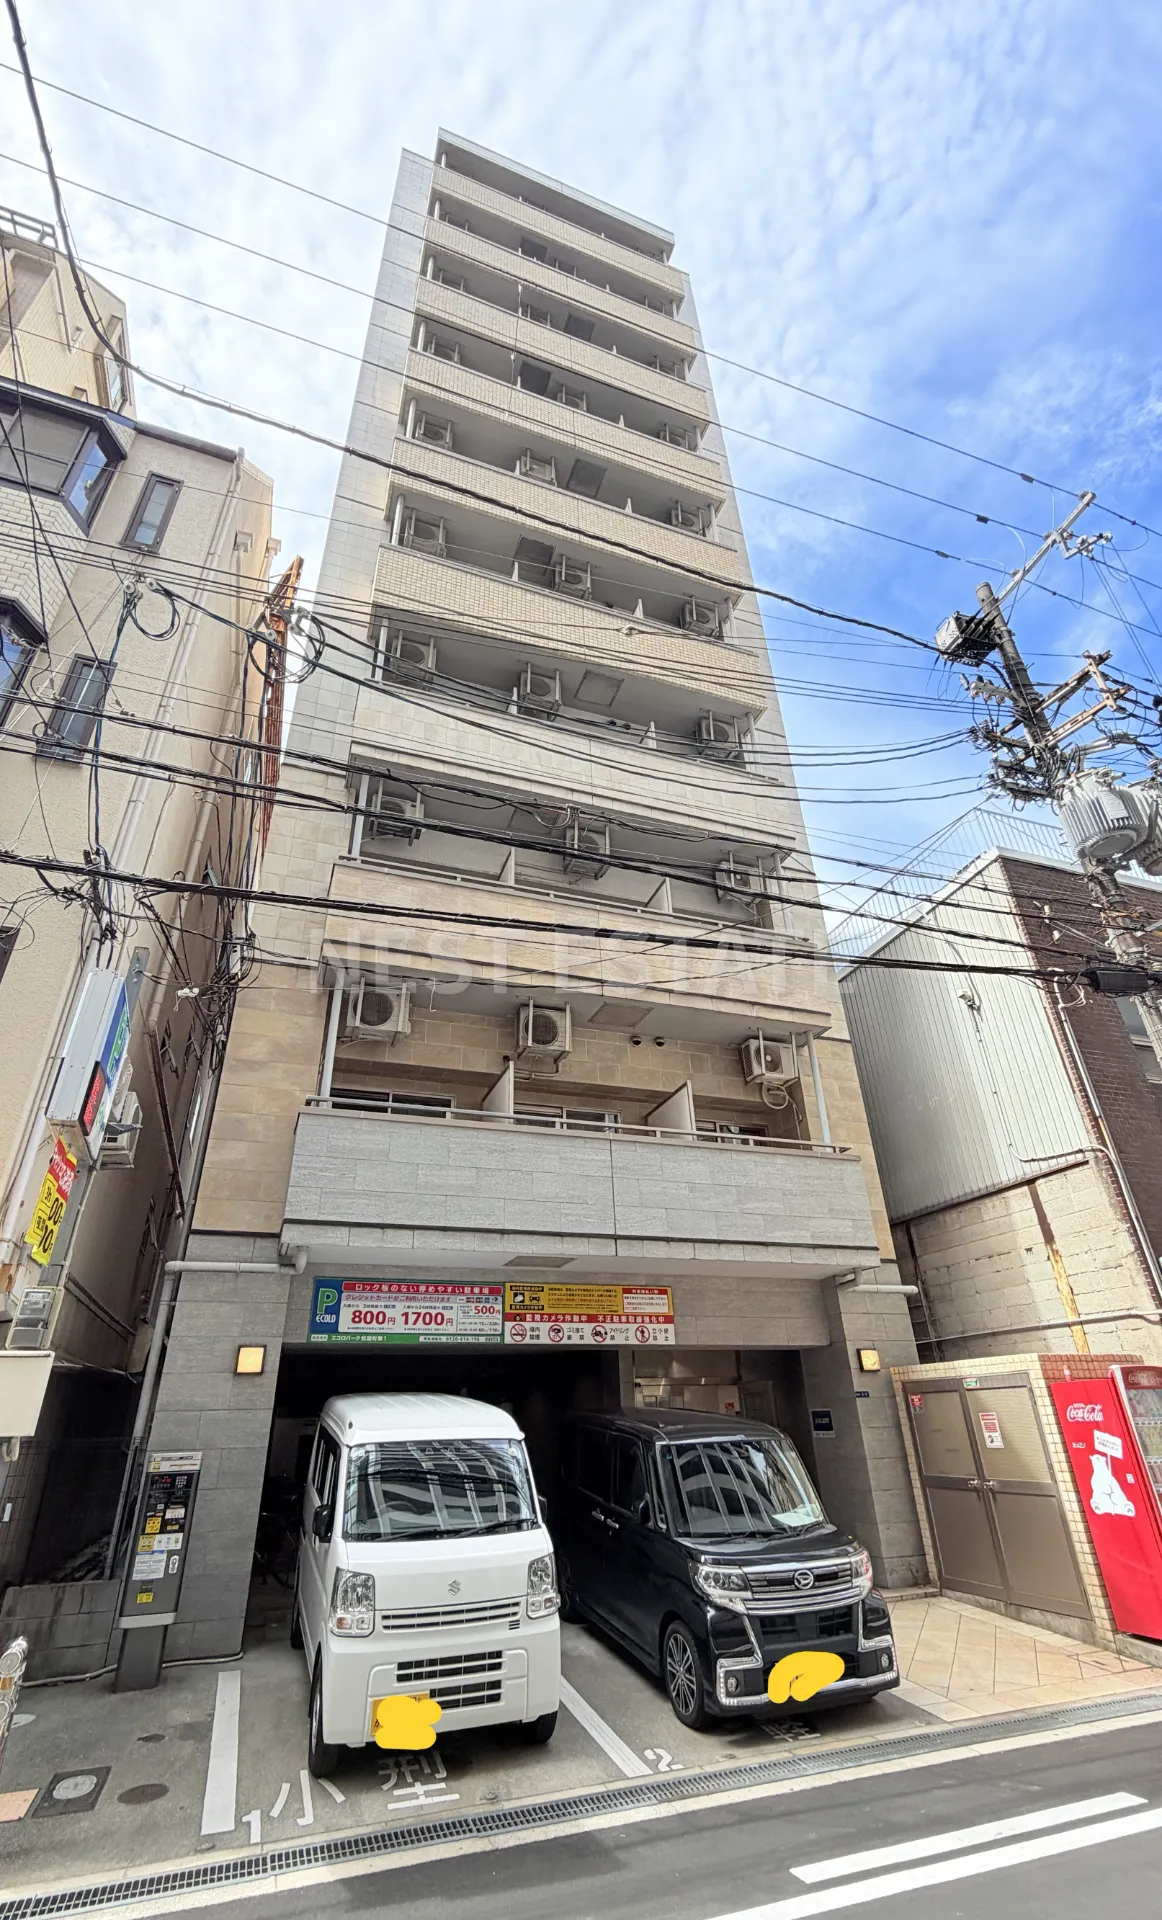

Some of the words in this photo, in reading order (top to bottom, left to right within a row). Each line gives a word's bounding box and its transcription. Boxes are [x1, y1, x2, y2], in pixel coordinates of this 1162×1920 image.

[355, 1283, 490, 1295] ロック板のない停めやすい駐車場
[525, 1314, 588, 1322] 監視カメラ作動中
[1067, 1402, 1104, 1423] Coca-Cola
[643, 1748, 685, 1772] 2
[241, 1809, 261, 1845] 1
